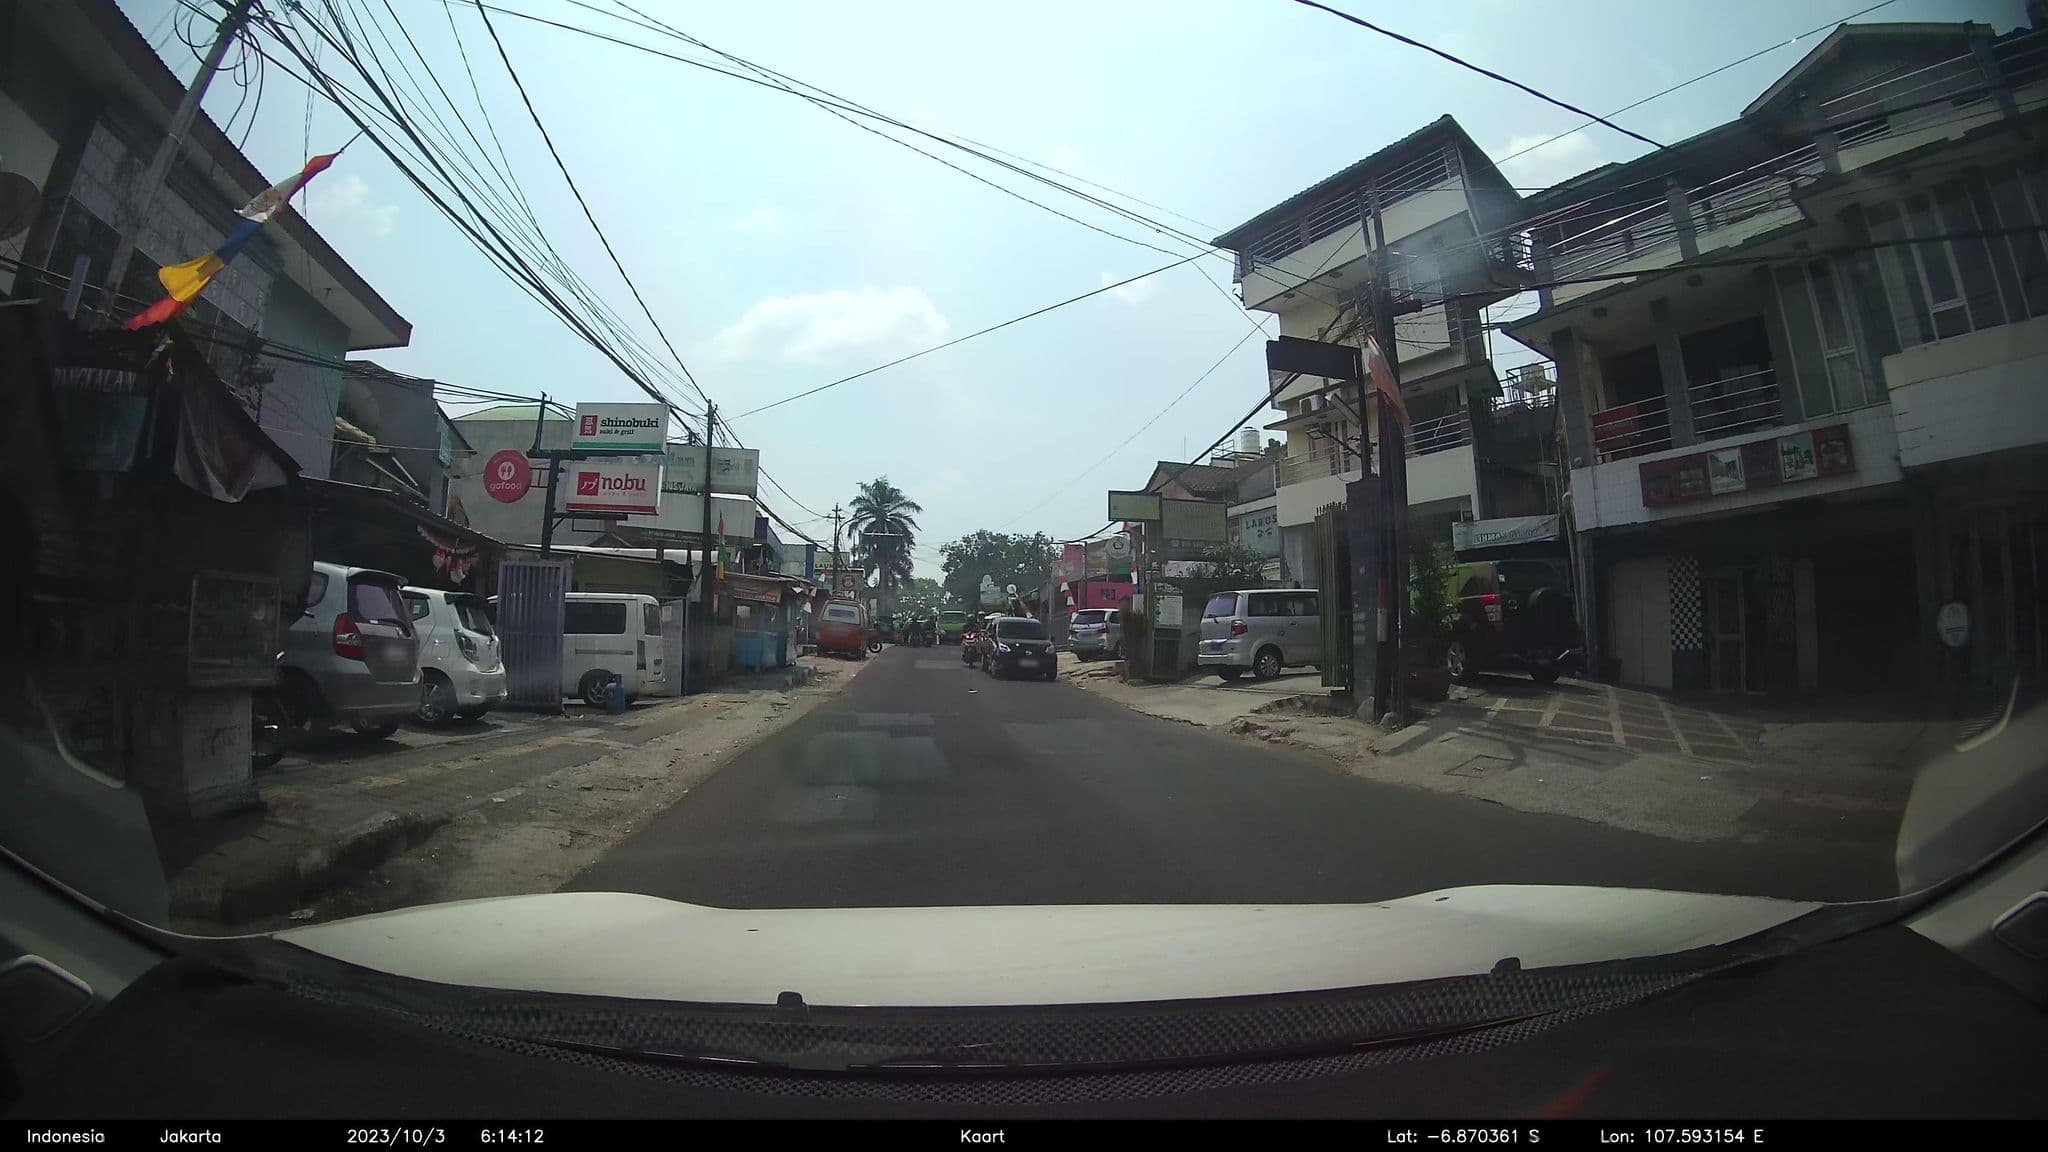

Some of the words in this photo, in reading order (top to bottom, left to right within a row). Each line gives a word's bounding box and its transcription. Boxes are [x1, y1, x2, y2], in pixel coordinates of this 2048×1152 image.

[600, 417, 660, 428] shinobuki
[620, 428, 634, 436] grill
[489, 482, 522, 492] gofood
[601, 473, 647, 491] nobu
